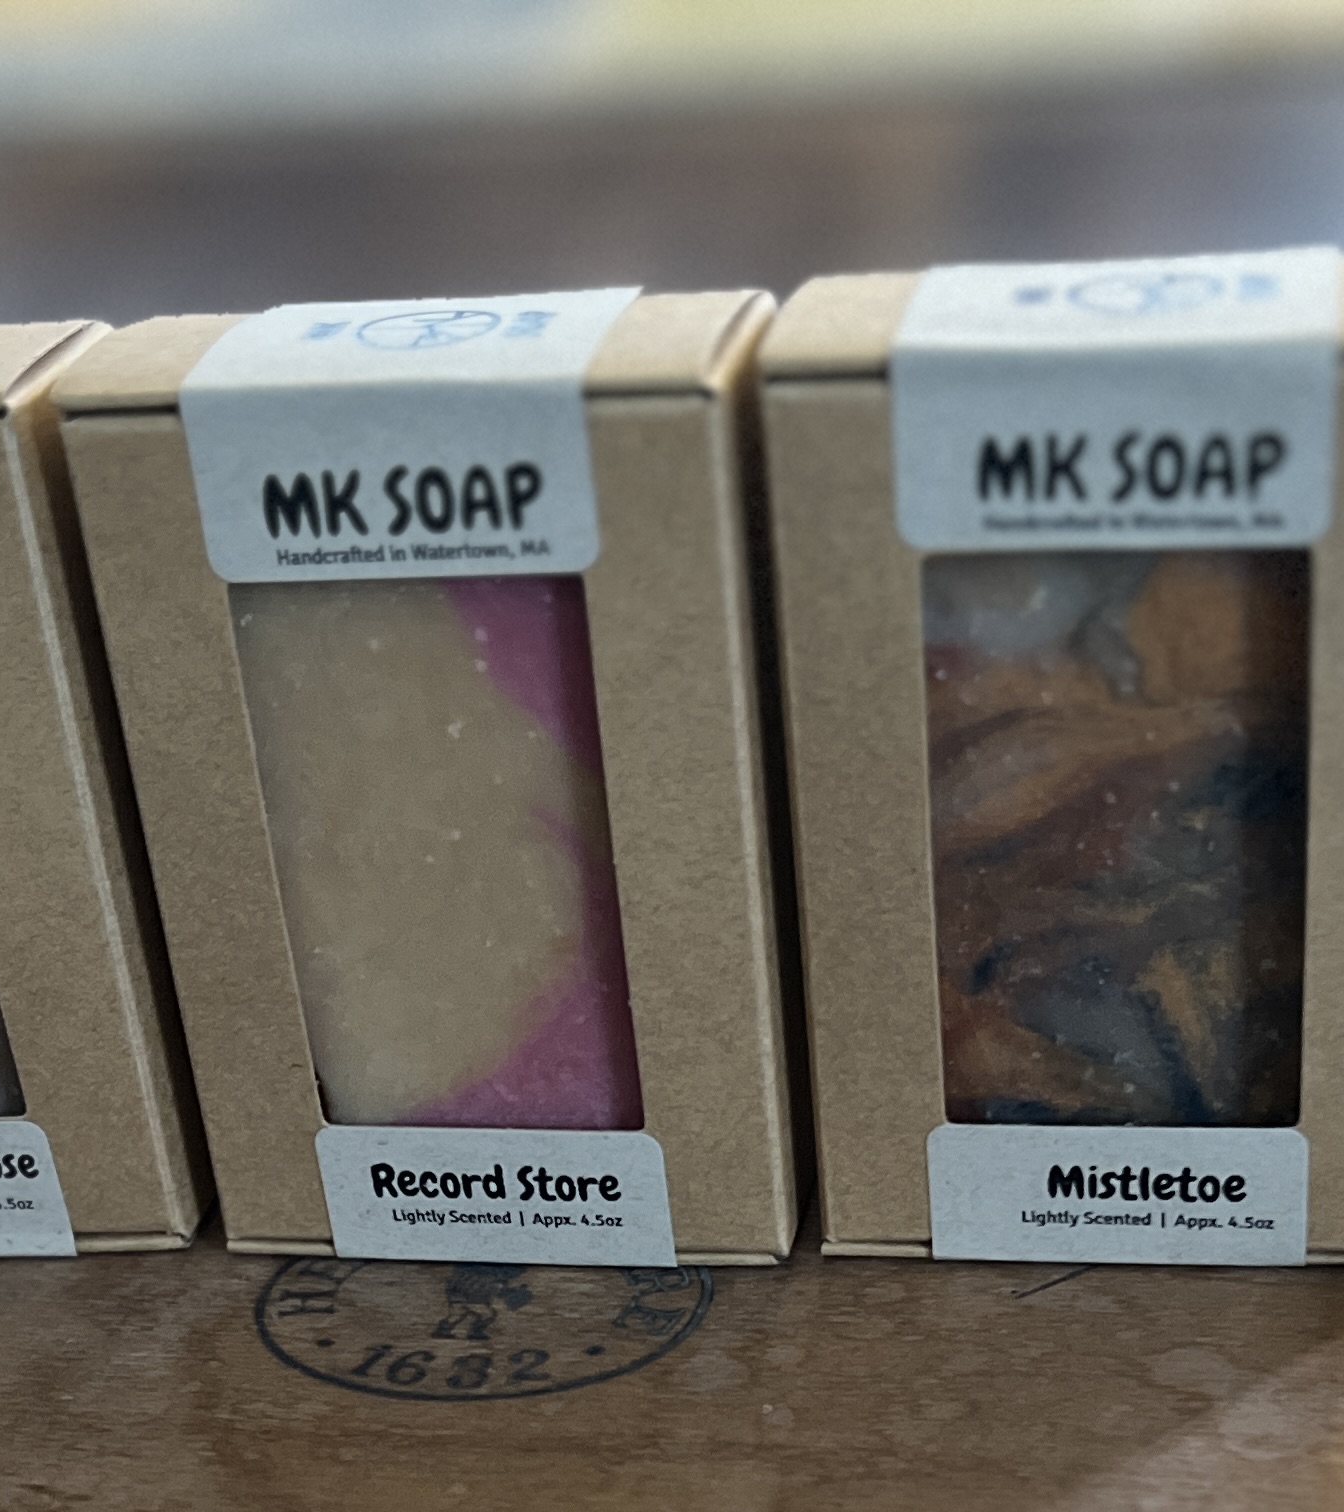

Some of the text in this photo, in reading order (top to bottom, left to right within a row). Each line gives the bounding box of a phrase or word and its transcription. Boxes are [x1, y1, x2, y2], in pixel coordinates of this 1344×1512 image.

[977, 430, 1286, 503] MK SOAP
[262, 462, 543, 538] MK SOAP
[276, 539, 551, 567] Handcrafted in Watertown, MA
[370, 1162, 623, 1202] Record Store
[1047, 1164, 1248, 1203] Mistletoe
[392, 1208, 446, 1226] Lightly
[448, 1209, 512, 1225] Scented
[532, 1212, 578, 1229] Appx.
[580, 1213, 624, 1228] 4.5oz
[1021, 1210, 1080, 1227] Lightly
[1083, 1211, 1152, 1226] Scented
[1173, 1213, 1224, 1230] Appx.
[1227, 1215, 1275, 1230] 4.5oz
